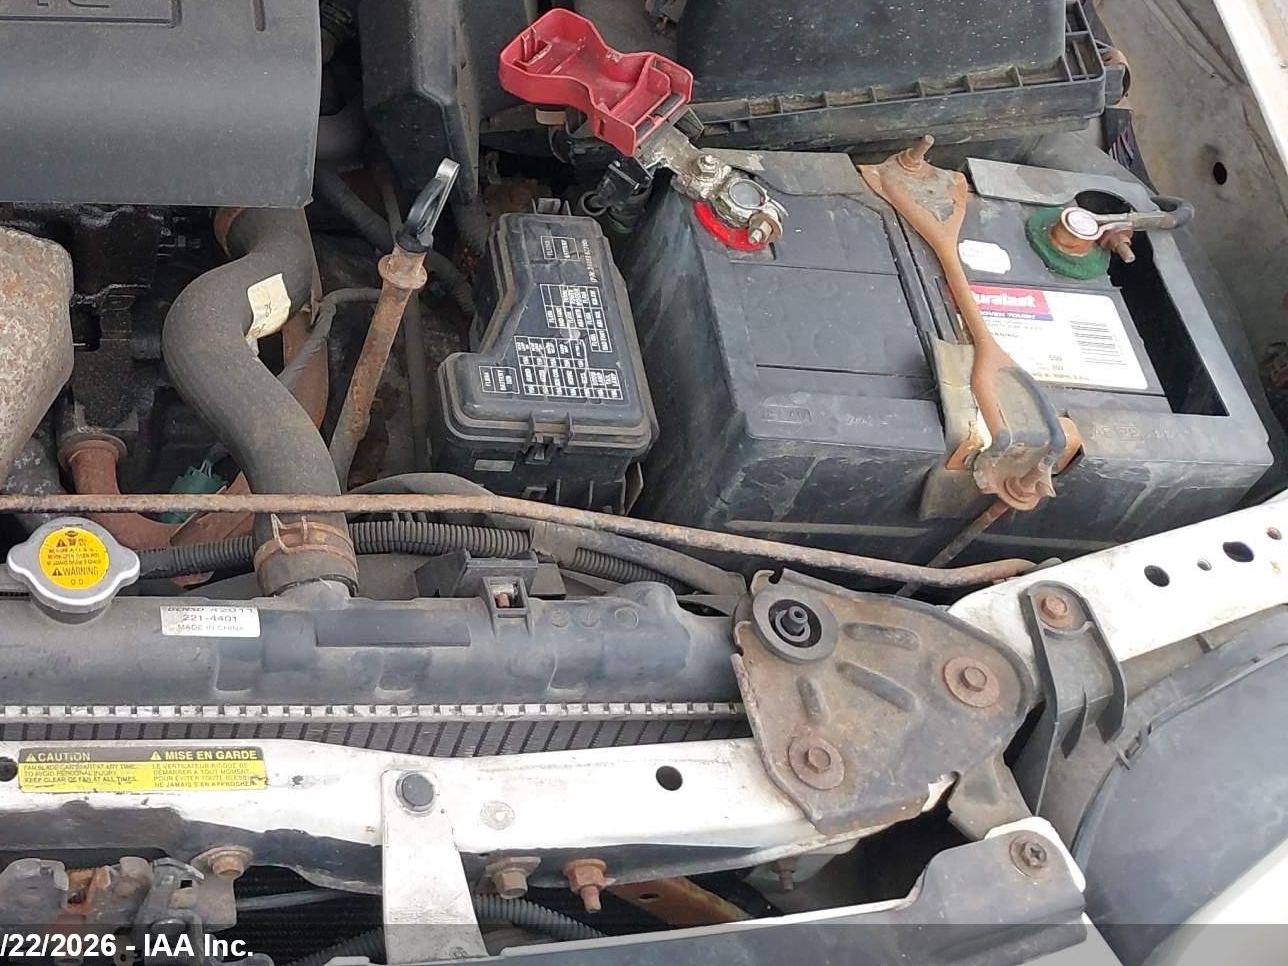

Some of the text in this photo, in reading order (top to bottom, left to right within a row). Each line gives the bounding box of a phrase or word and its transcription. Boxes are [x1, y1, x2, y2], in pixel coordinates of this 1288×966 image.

[63, 566, 99, 576] WARNING
[183, 614, 237, 623] 221-4401
[38, 751, 90, 762] CAUTION
[165, 749, 258, 760] MISE EN GARDE
